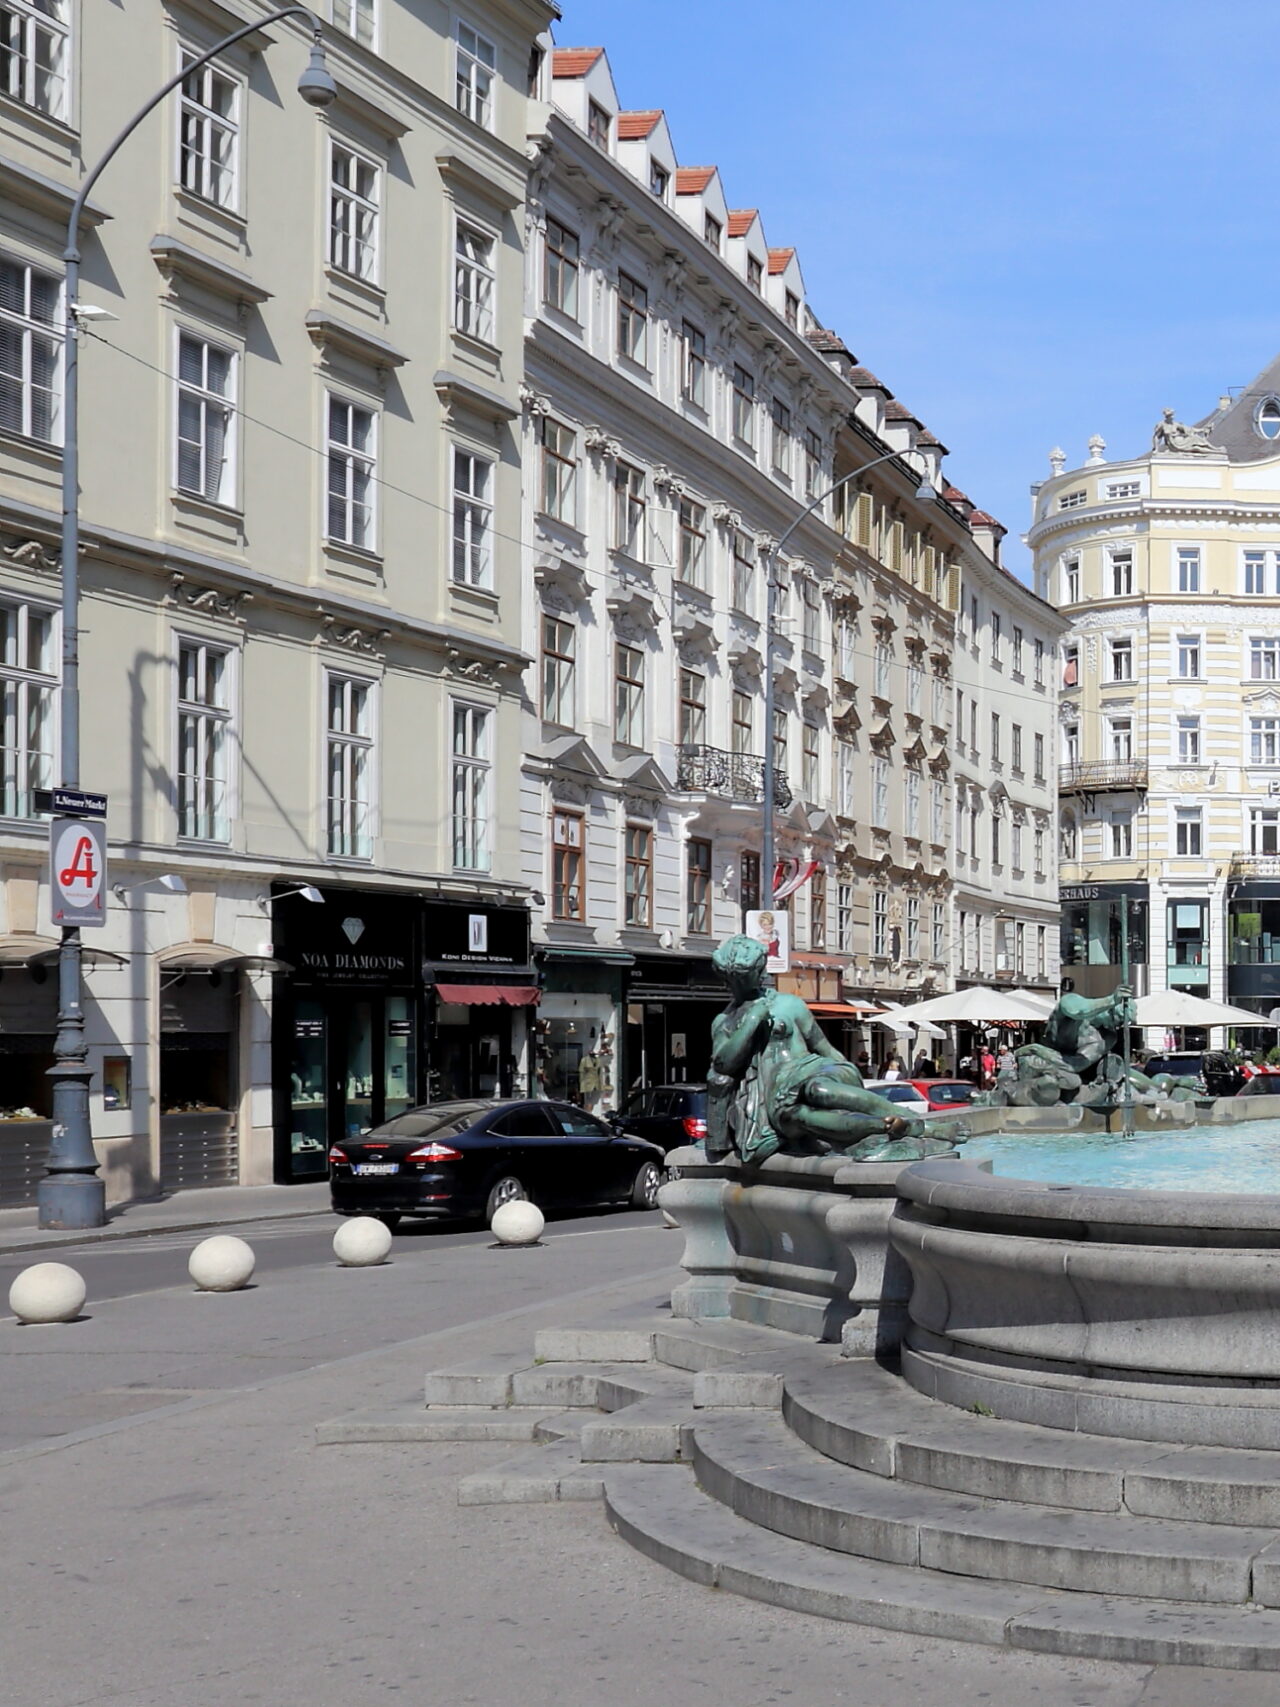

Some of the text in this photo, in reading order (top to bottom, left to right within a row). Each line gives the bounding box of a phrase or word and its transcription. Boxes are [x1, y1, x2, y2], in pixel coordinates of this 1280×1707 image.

[84, 799, 106, 811] Markt
[301, 953, 405, 970] NOA DIAMONDS
